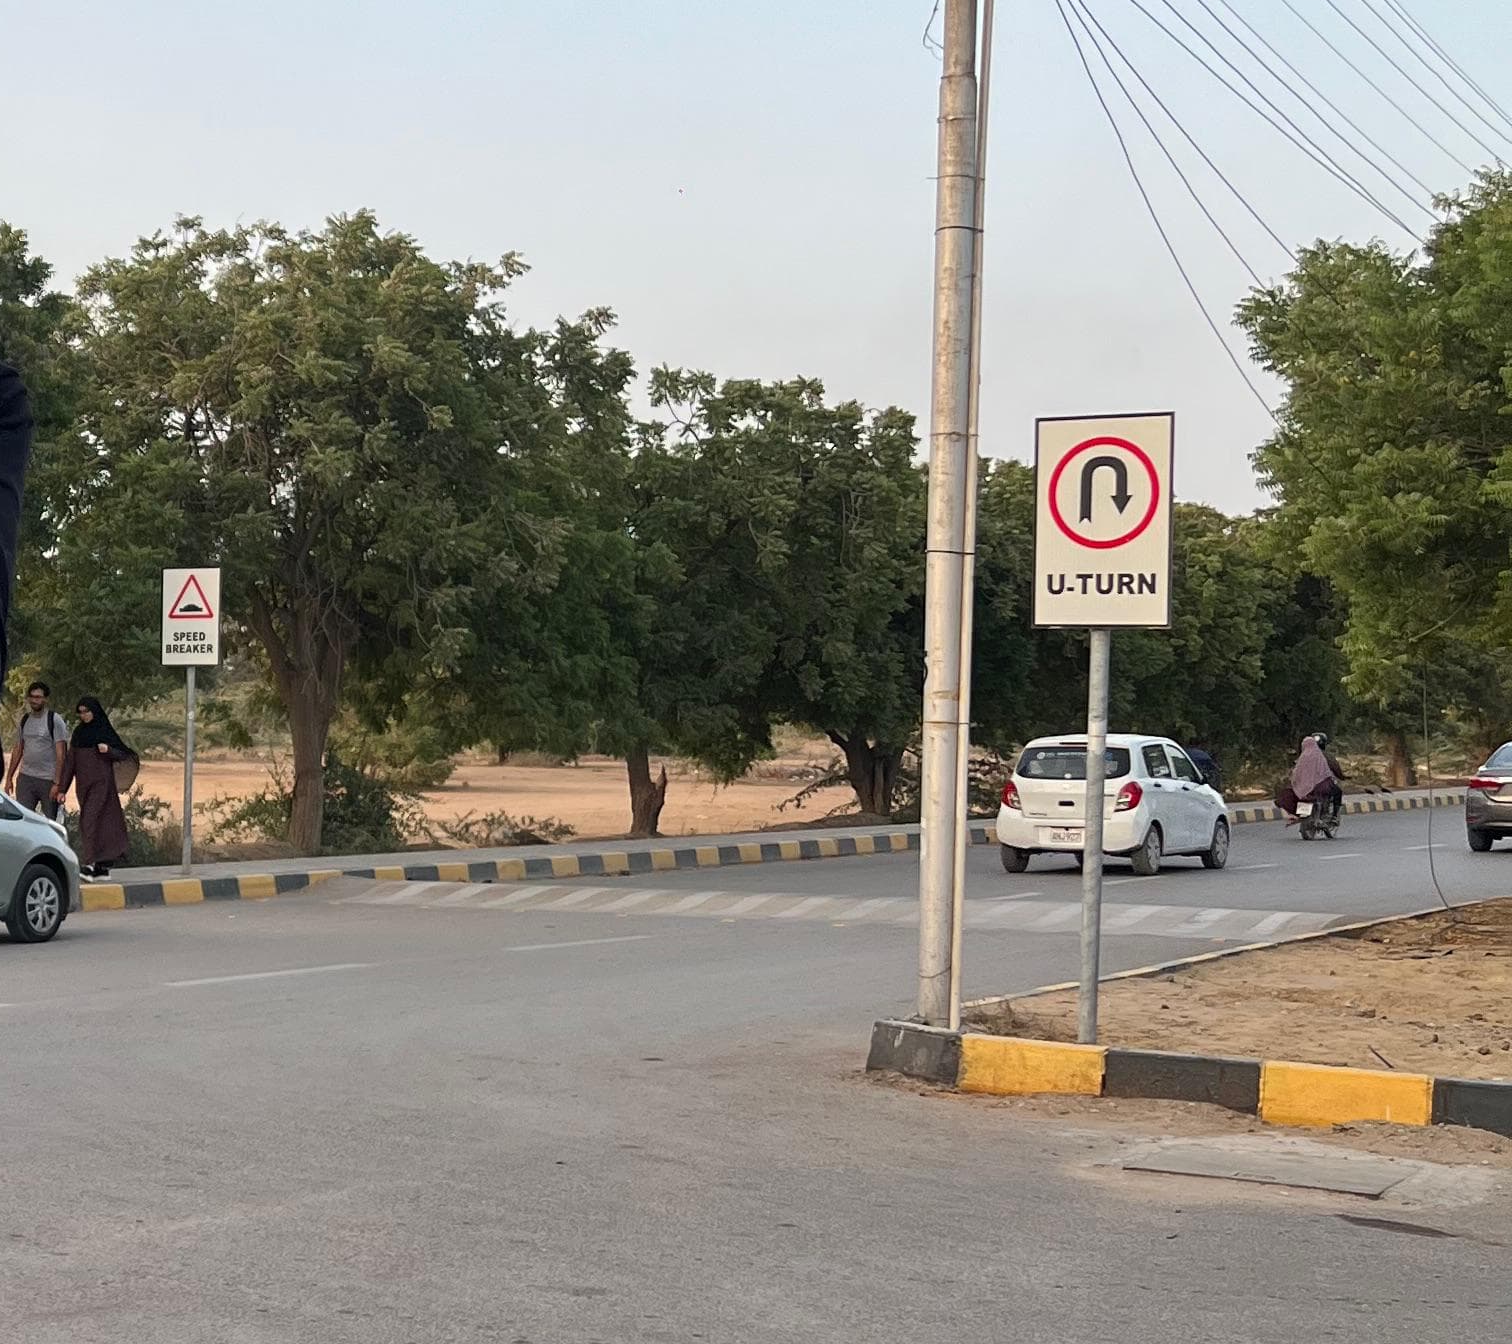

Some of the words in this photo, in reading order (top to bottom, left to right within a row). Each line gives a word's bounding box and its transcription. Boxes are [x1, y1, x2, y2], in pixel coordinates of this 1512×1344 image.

[1047, 573, 1157, 595] U-TURN
[173, 632, 206, 641] SPEED
[166, 644, 213, 653] BREAKER
